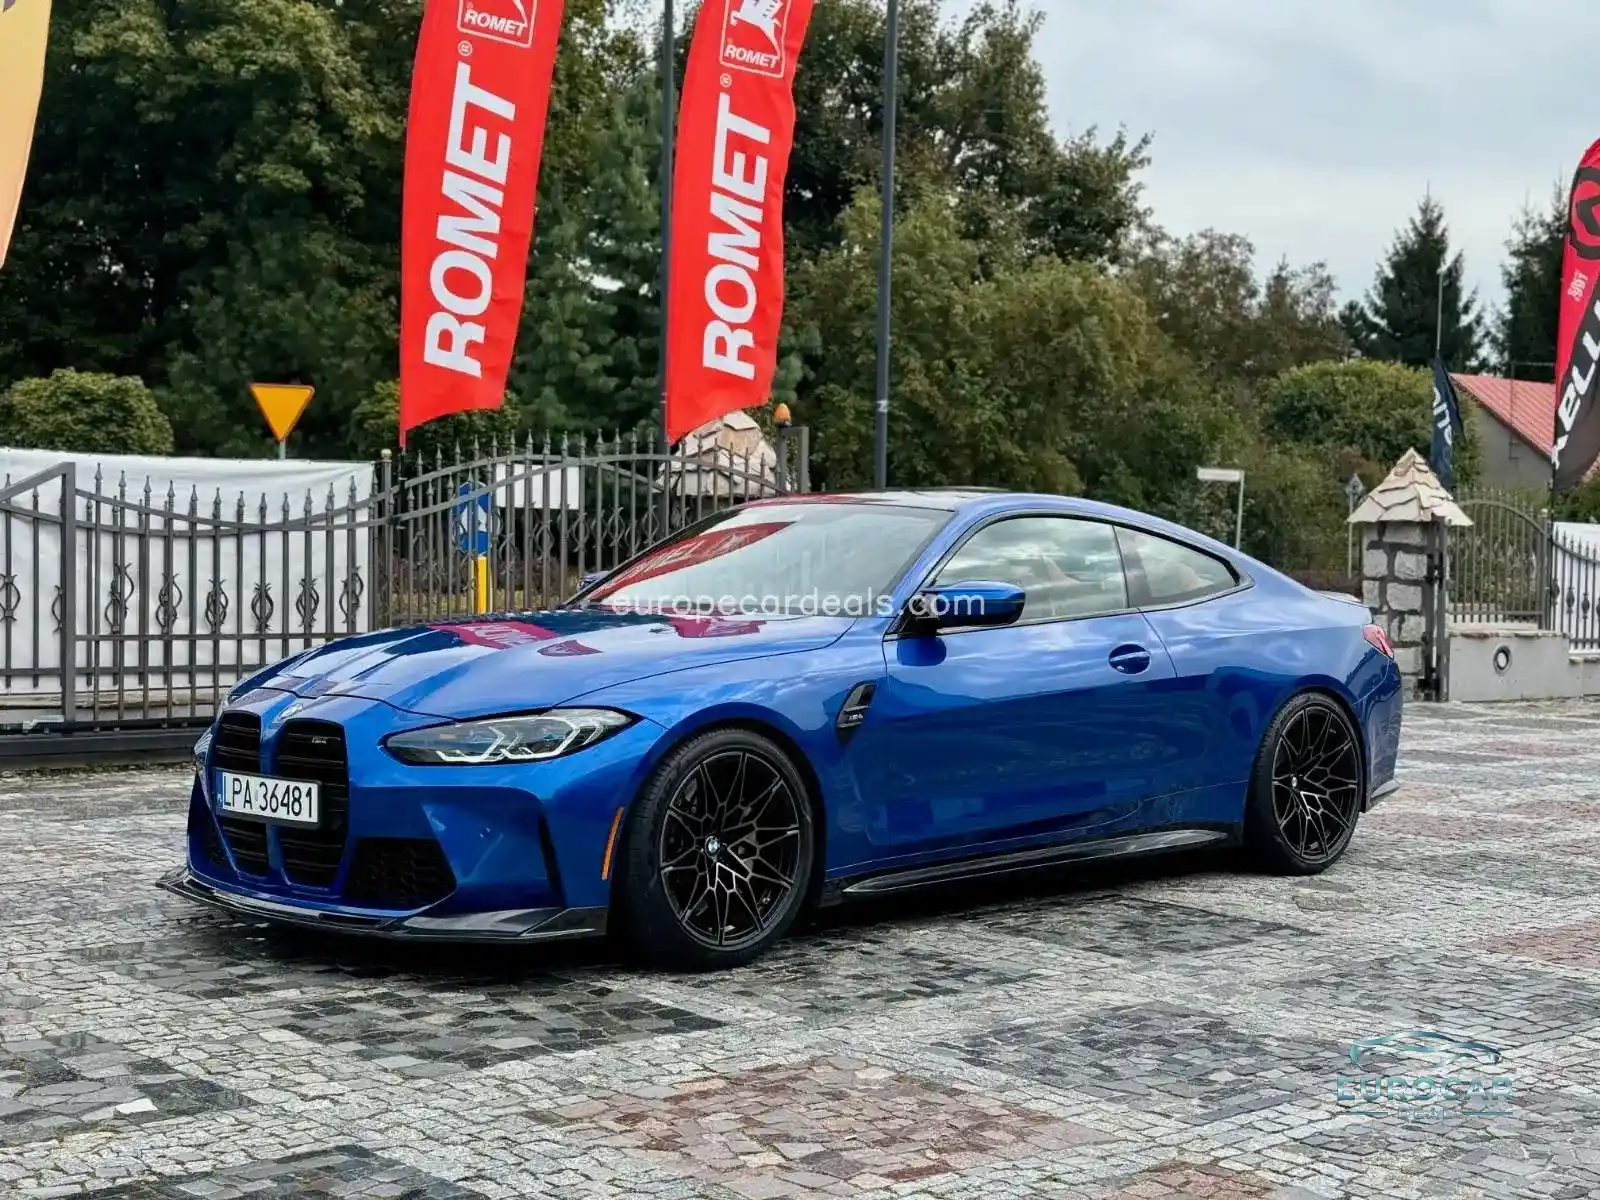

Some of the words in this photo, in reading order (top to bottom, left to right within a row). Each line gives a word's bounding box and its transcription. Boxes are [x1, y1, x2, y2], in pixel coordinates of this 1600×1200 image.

[464, 9, 528, 37] ROMET
[724, 44, 781, 69] ROMET
[423, 61, 516, 379] ROMET
[702, 92, 771, 380] ROMET
